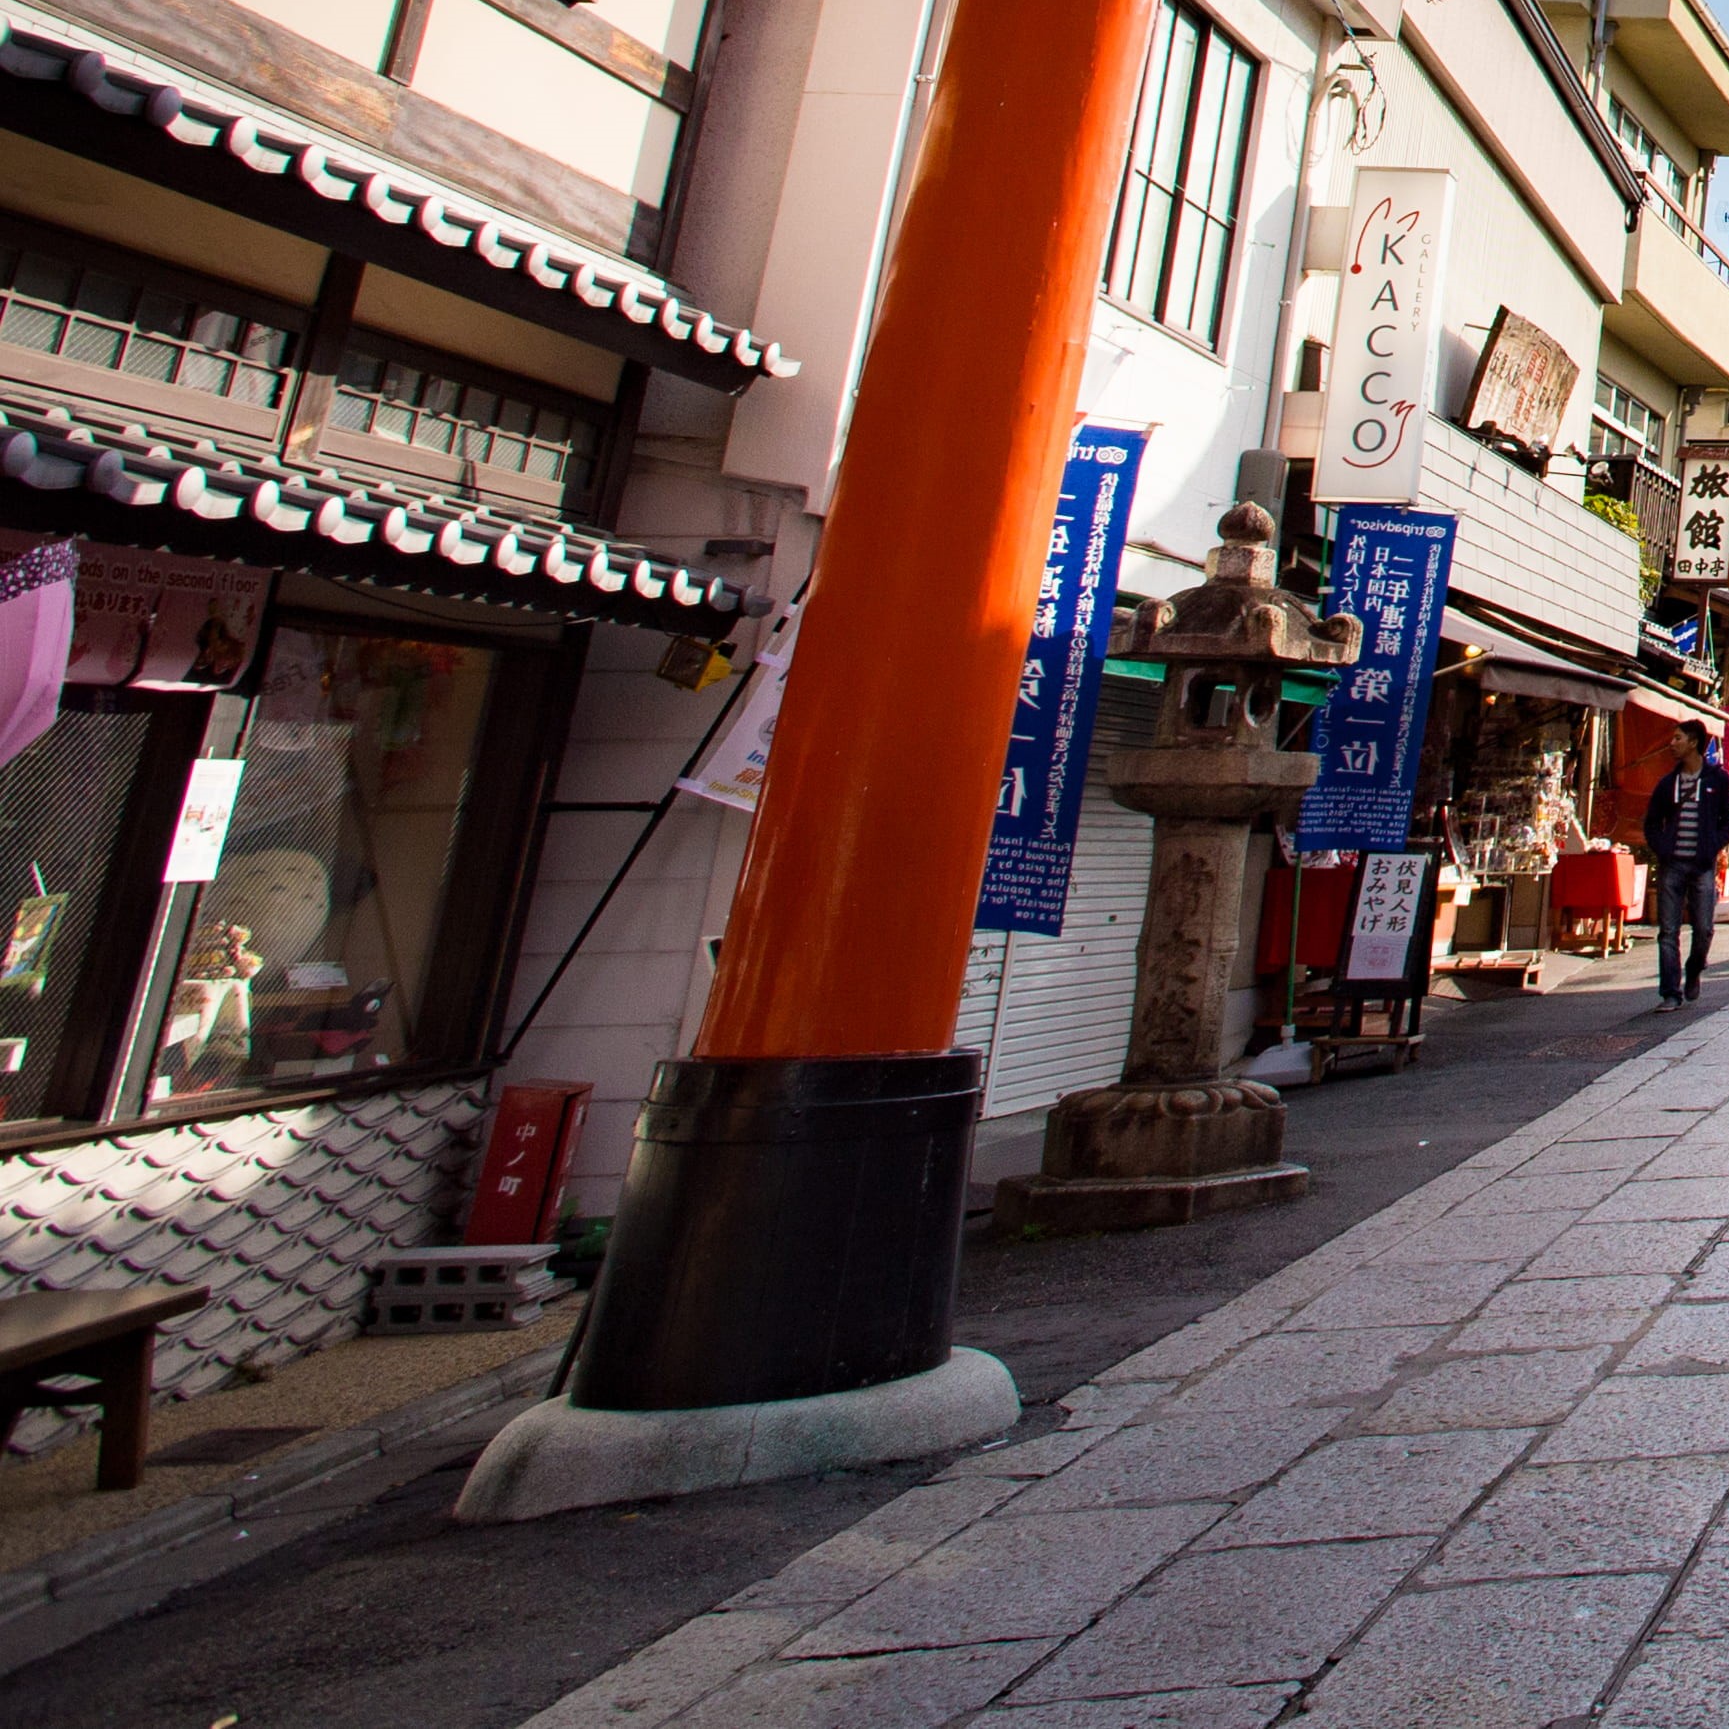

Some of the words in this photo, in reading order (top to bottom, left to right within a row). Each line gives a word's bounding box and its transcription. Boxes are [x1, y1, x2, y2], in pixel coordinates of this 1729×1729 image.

[1409, 232, 1431, 334] GALLERY
[1353, 230, 1408, 454] KACCO
[81, 562, 101, 578] ods
[112, 565, 129, 580] on
[136, 567, 160, 585] the
[166, 571, 214, 591] second
[221, 573, 259, 593] floor
[1677, 557, 1725, 578] 田中亭
[1360, 858, 1392, 933] おみやげ
[1386, 859, 1418, 932] 伏見人形
[498, 1122, 537, 1196] 中ノ町
